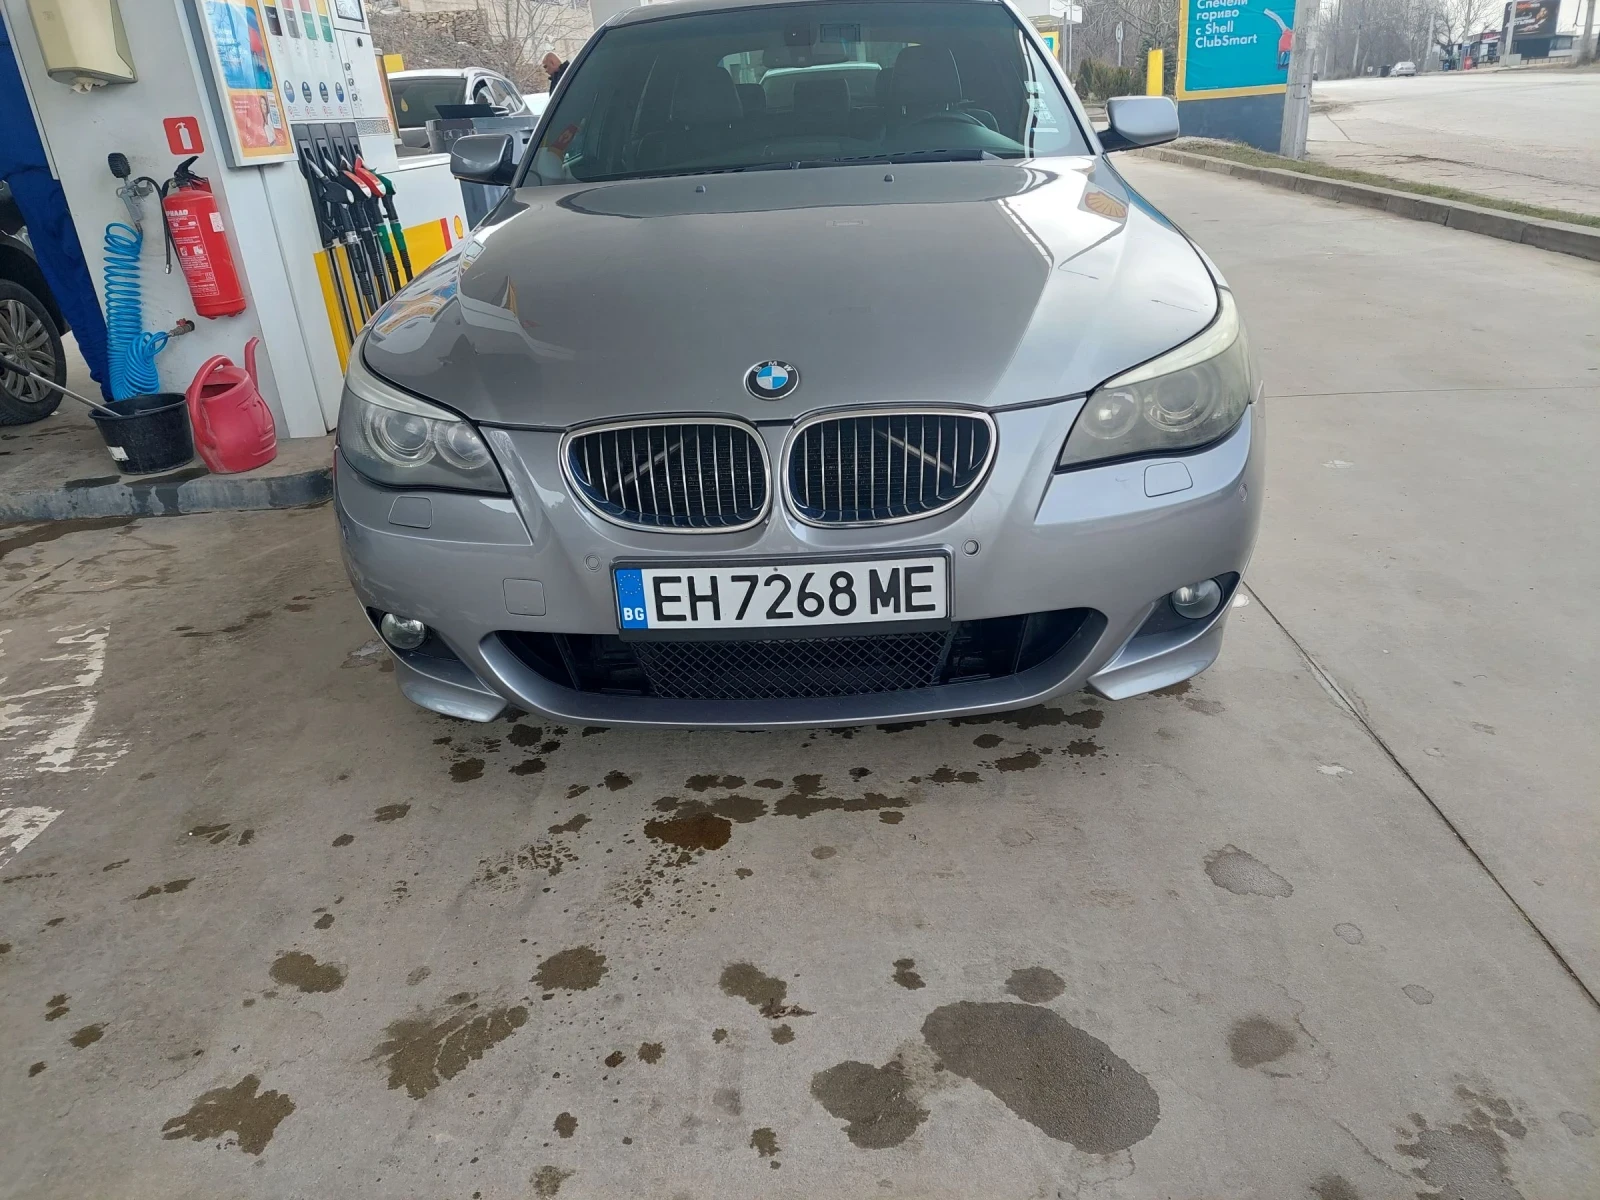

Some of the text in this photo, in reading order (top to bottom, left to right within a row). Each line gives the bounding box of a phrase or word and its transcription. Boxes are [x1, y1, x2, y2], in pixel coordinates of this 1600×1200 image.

[1197, 0, 1247, 9] Спечели
[1196, 9, 1239, 22] гориво
[1195, 20, 1234, 36] с Shell
[1195, 34, 1257, 48] ClubSmart
[753, 361, 794, 372] BMW
[623, 606, 645, 621] BG
